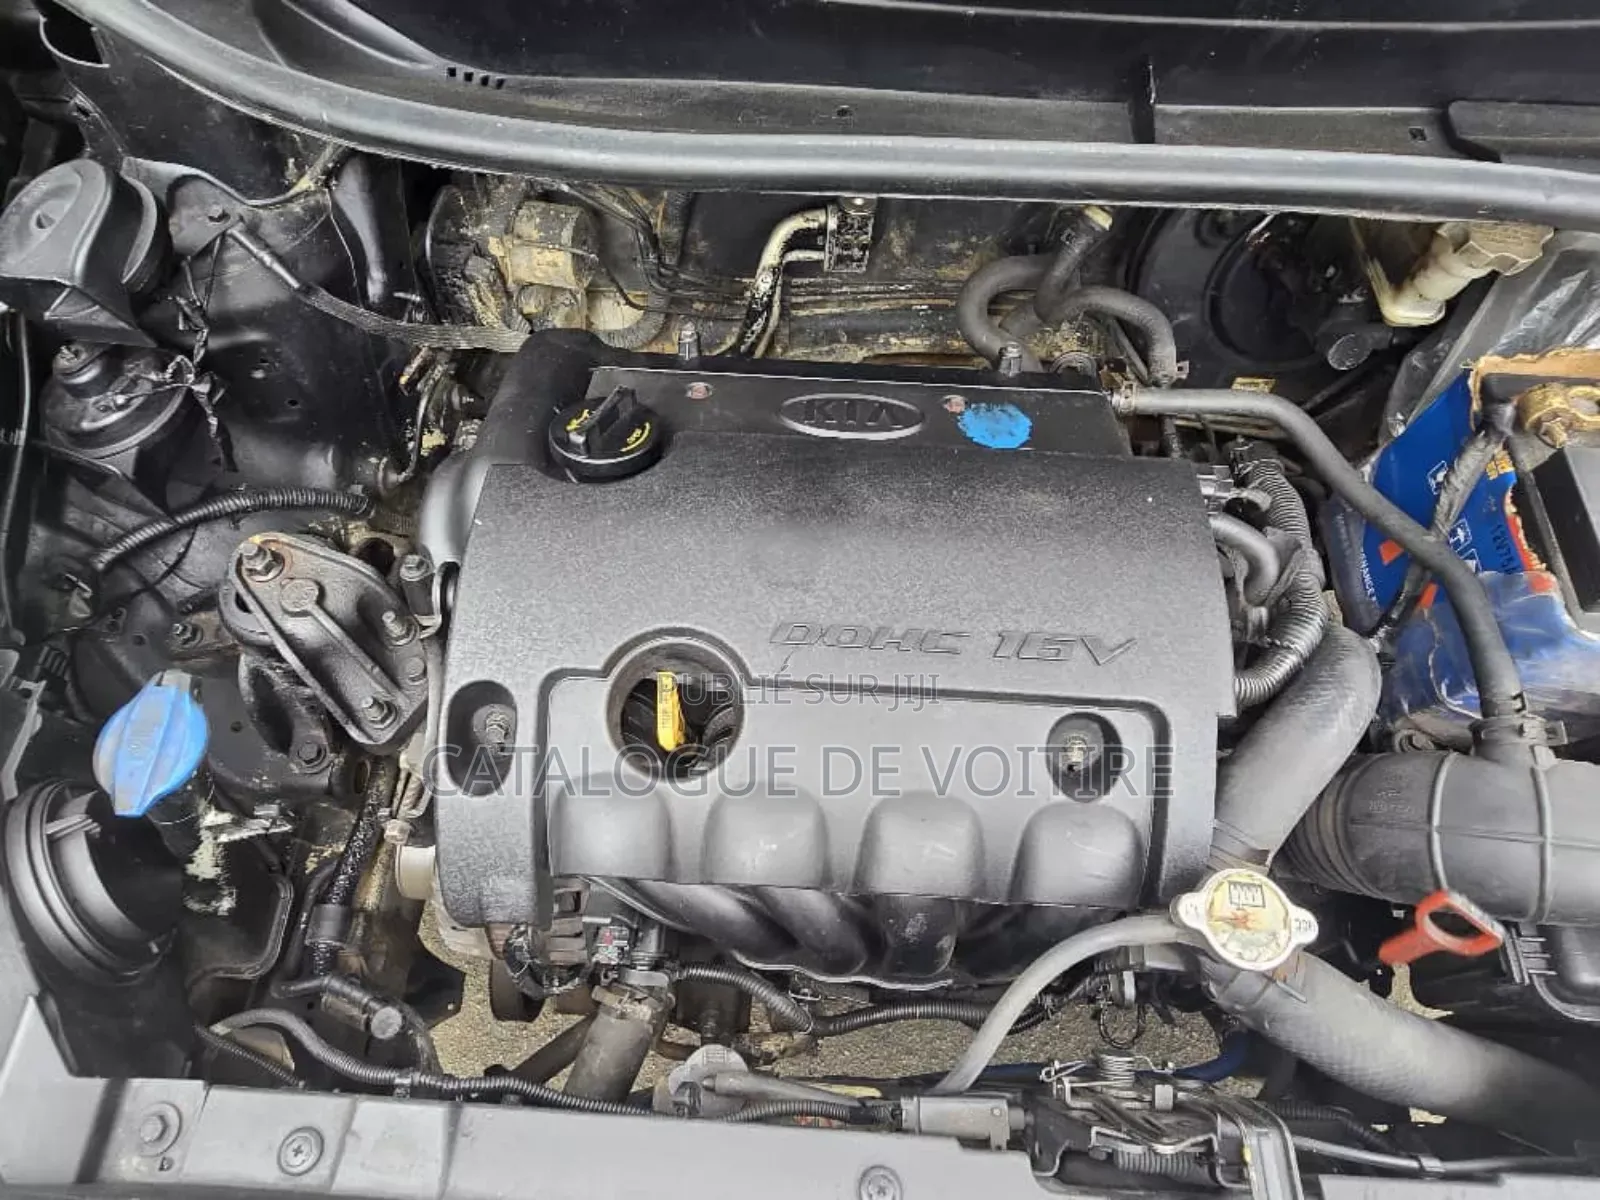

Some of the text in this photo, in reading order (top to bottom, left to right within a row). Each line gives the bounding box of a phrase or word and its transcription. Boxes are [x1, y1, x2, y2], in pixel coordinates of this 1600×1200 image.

[803, 400, 904, 428] KIA
[769, 622, 1137, 667] DOHC 16V
